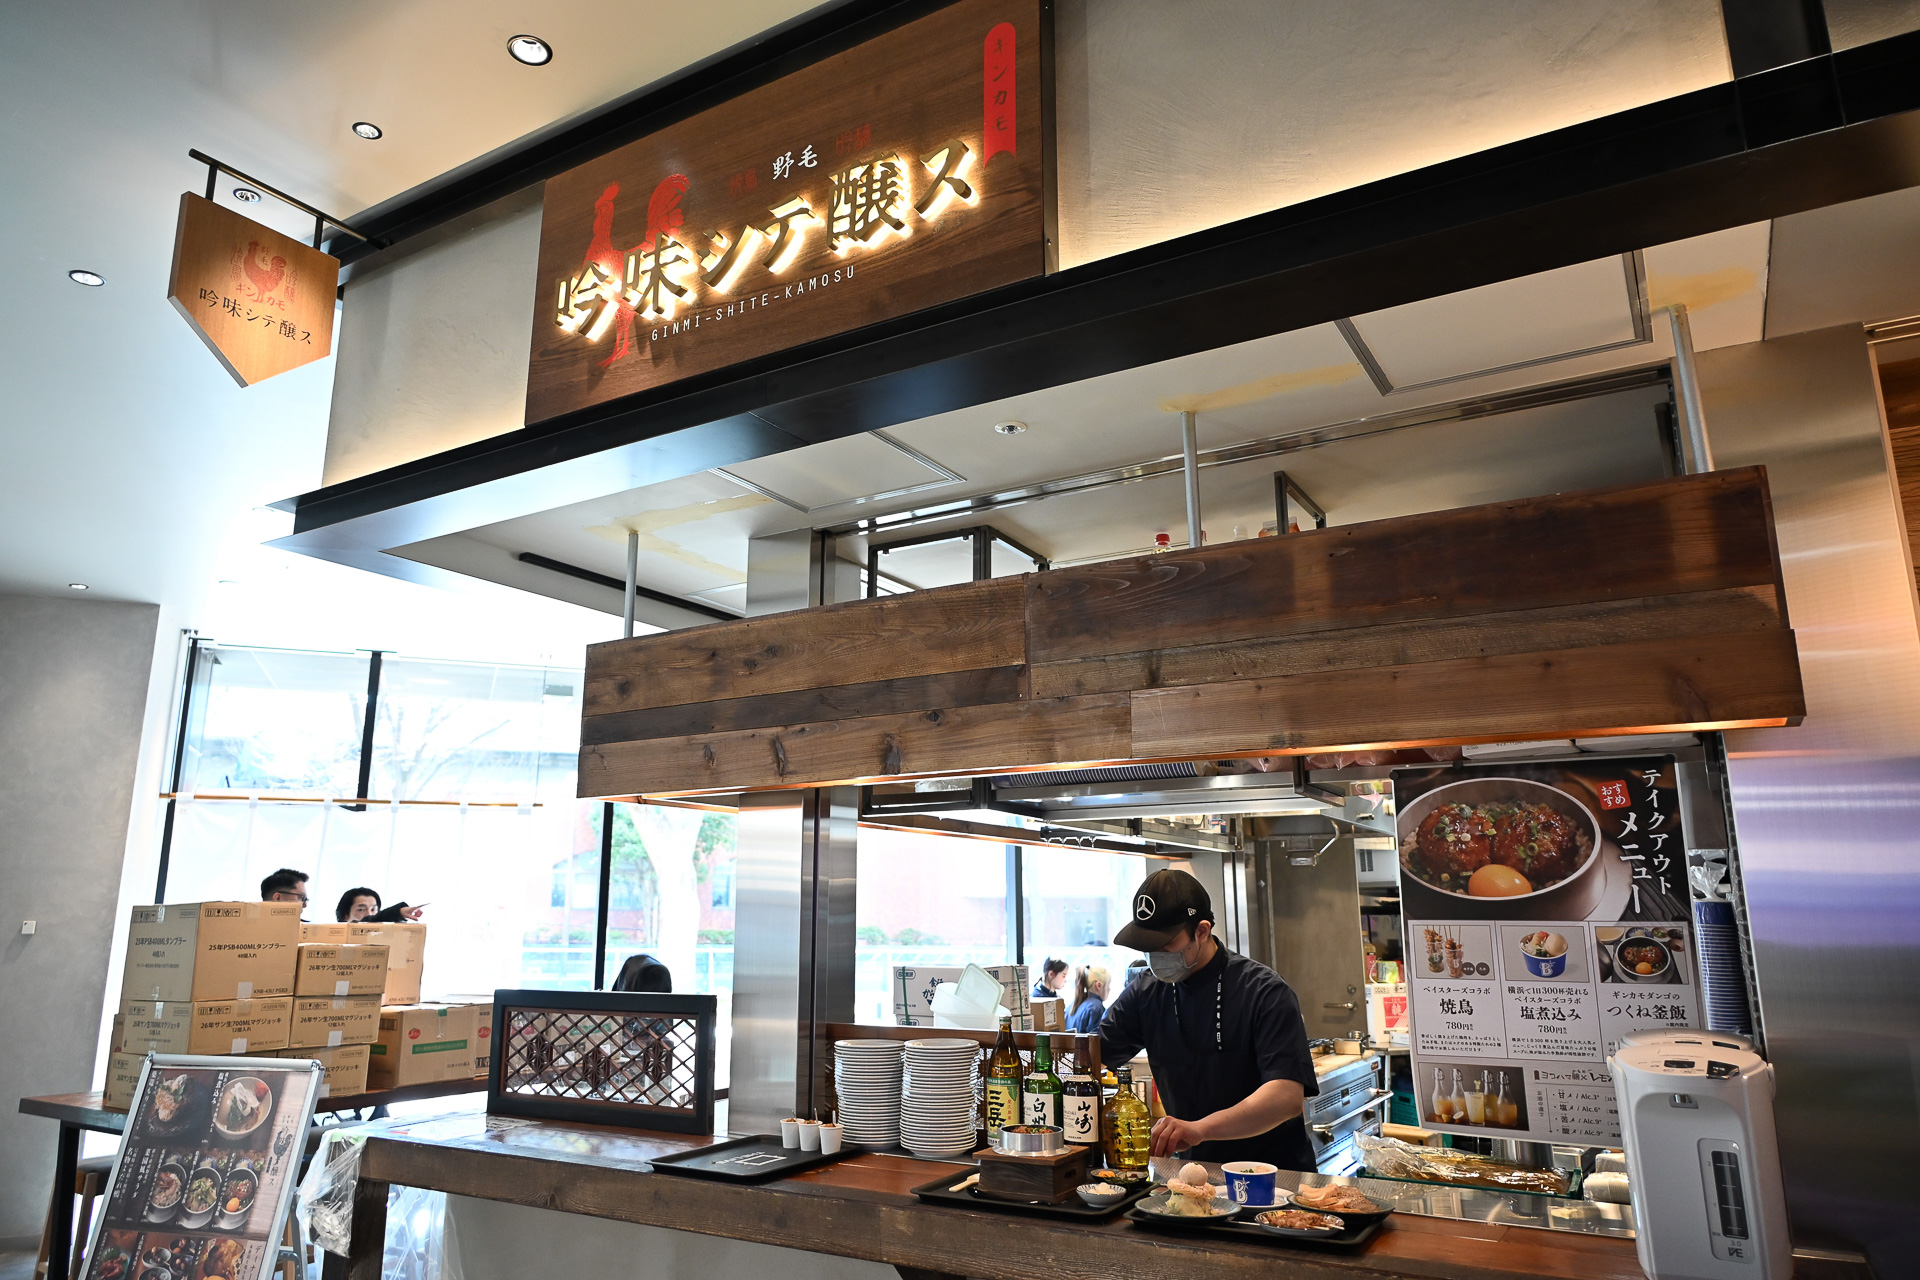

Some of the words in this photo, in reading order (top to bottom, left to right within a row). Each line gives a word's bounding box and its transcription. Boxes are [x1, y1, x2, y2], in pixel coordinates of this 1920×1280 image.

[772, 144, 818, 180] 野毛
[554, 138, 974, 342] 吟味シテ醸ス
[200, 287, 312, 345] 吟味シテ醸ス
[650, 265, 856, 342] GINMI-SHITE-KAMOSU
[1641, 769, 1672, 896] テイクアウト
[1617, 812, 1653, 914] メニュー
[1423, 986, 1491, 995] ベイスターズコラボ
[1440, 998, 1474, 1015] 焼鳥
[1515, 996, 1582, 1004] ベイスターズコラボ
[1612, 991, 1680, 1000] ギンカモダンゴの
[1520, 1006, 1582, 1021] 塩煮込み
[1606, 1004, 1687, 1020] つくね釜飯
[988, 1090, 1006, 1128] 三岳
[1032, 1097, 1047, 1125] 白州
